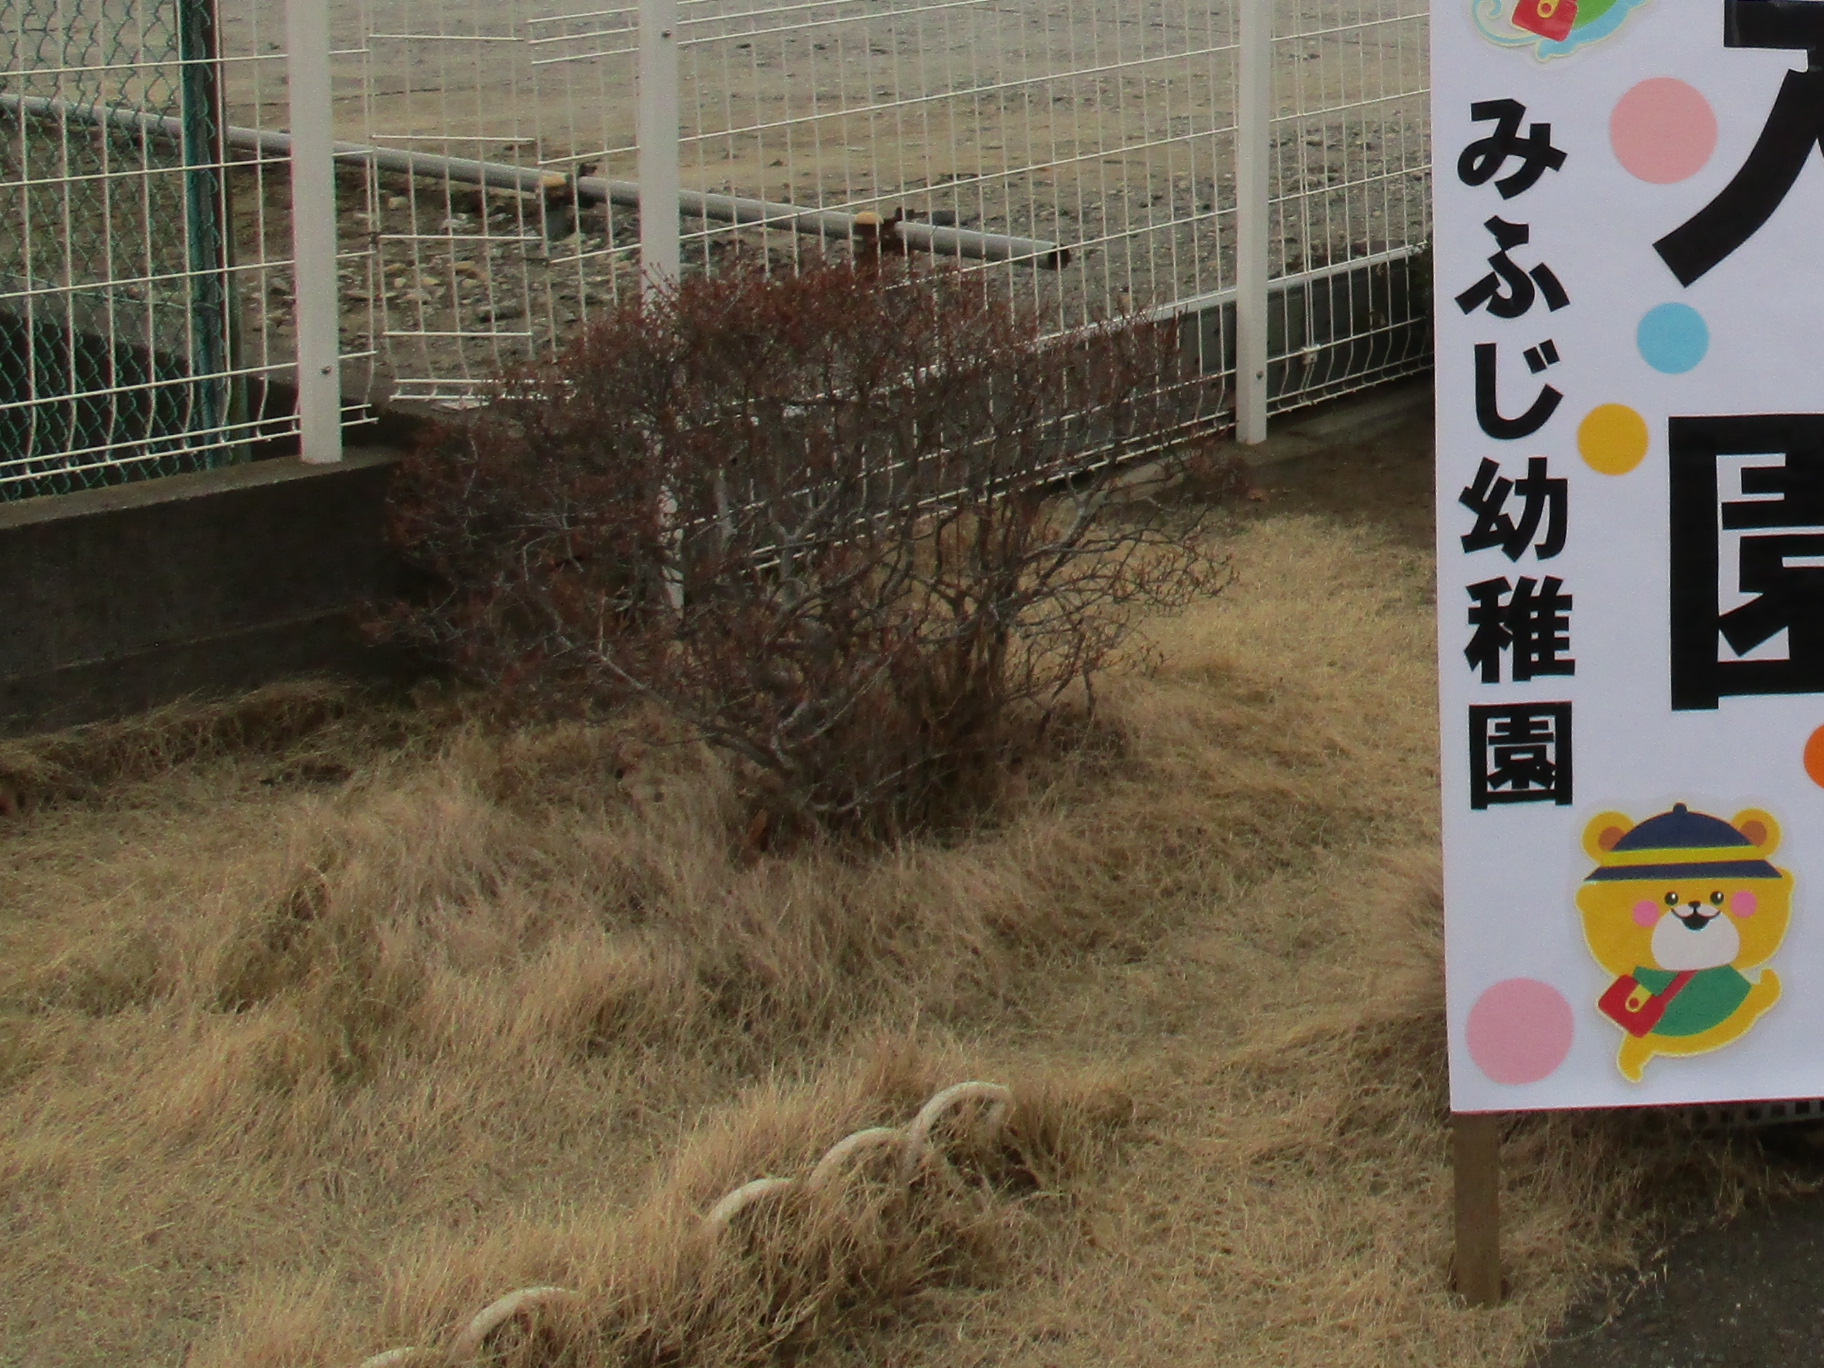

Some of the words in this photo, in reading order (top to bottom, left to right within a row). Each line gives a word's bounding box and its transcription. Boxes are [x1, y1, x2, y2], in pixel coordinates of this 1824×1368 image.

[1455, 98, 1576, 811] みふじ幼稚園
